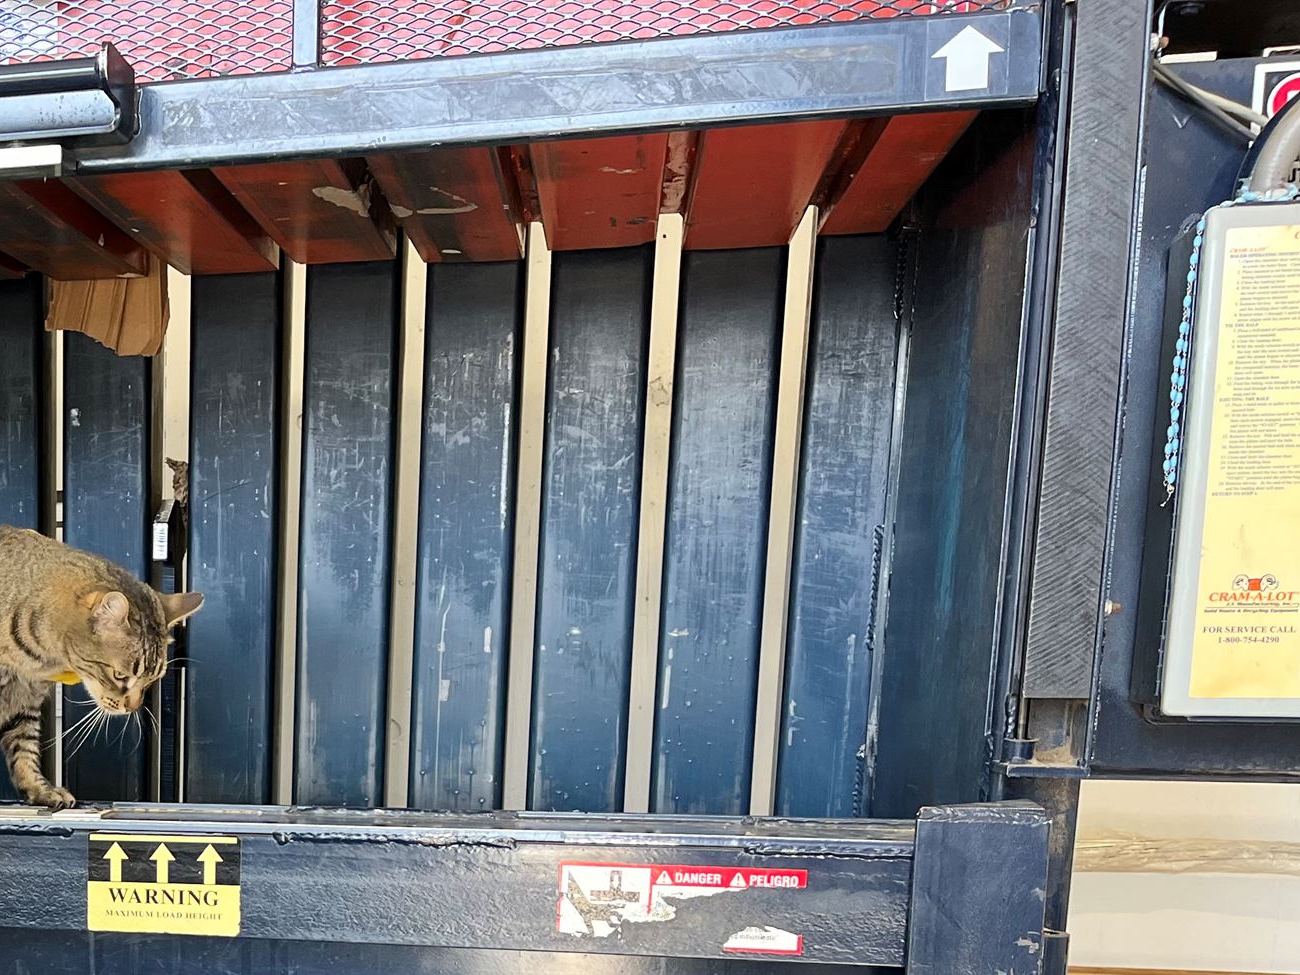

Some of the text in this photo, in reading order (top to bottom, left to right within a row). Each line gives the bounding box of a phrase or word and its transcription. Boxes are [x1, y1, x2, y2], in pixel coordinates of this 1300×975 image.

[1203, 626, 1297, 634] FOR SERVICE CALL
[1218, 636, 1280, 644] 1-800-754-4290
[675, 872, 798, 888] DANGER PELIGRO
[109, 888, 218, 907] WARNING
[105, 909, 223, 920] MAXIMUM LOAD HEIGHT
